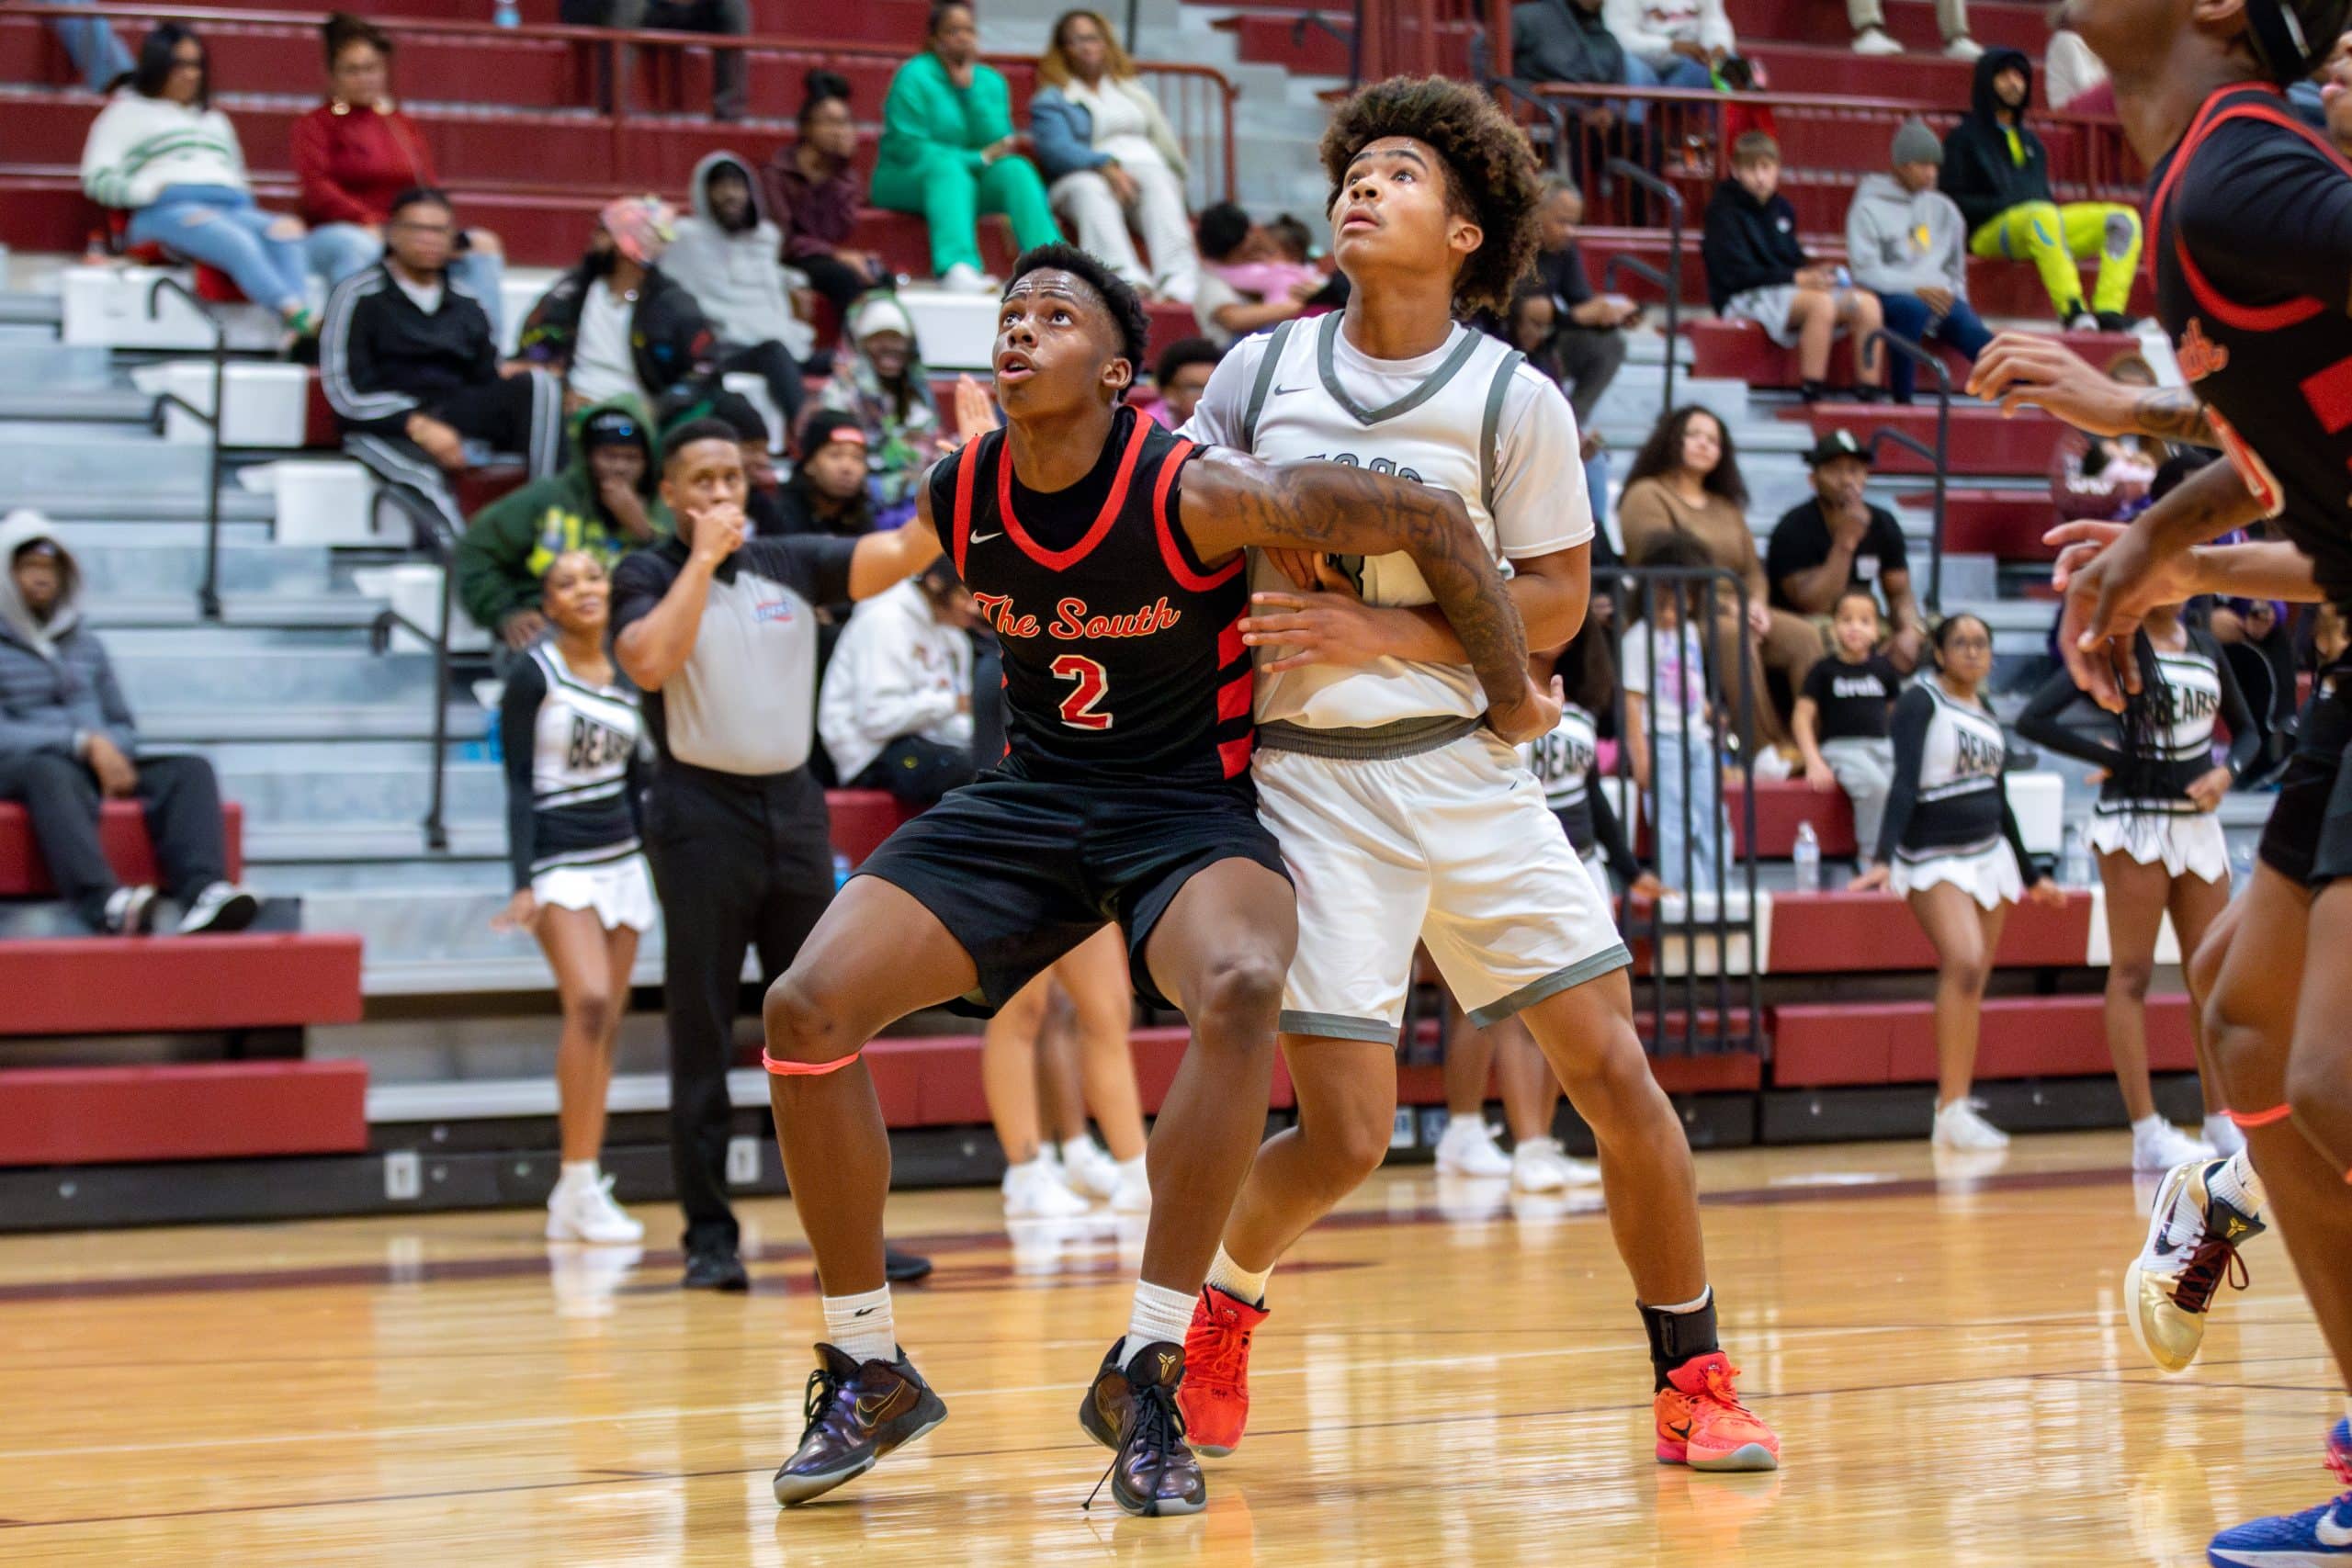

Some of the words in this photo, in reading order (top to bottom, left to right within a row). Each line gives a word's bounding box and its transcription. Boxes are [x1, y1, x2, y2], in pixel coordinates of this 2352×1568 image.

[973, 592, 1040, 638] The
[1048, 597, 1182, 640] South
[1049, 654, 1114, 730] 2
